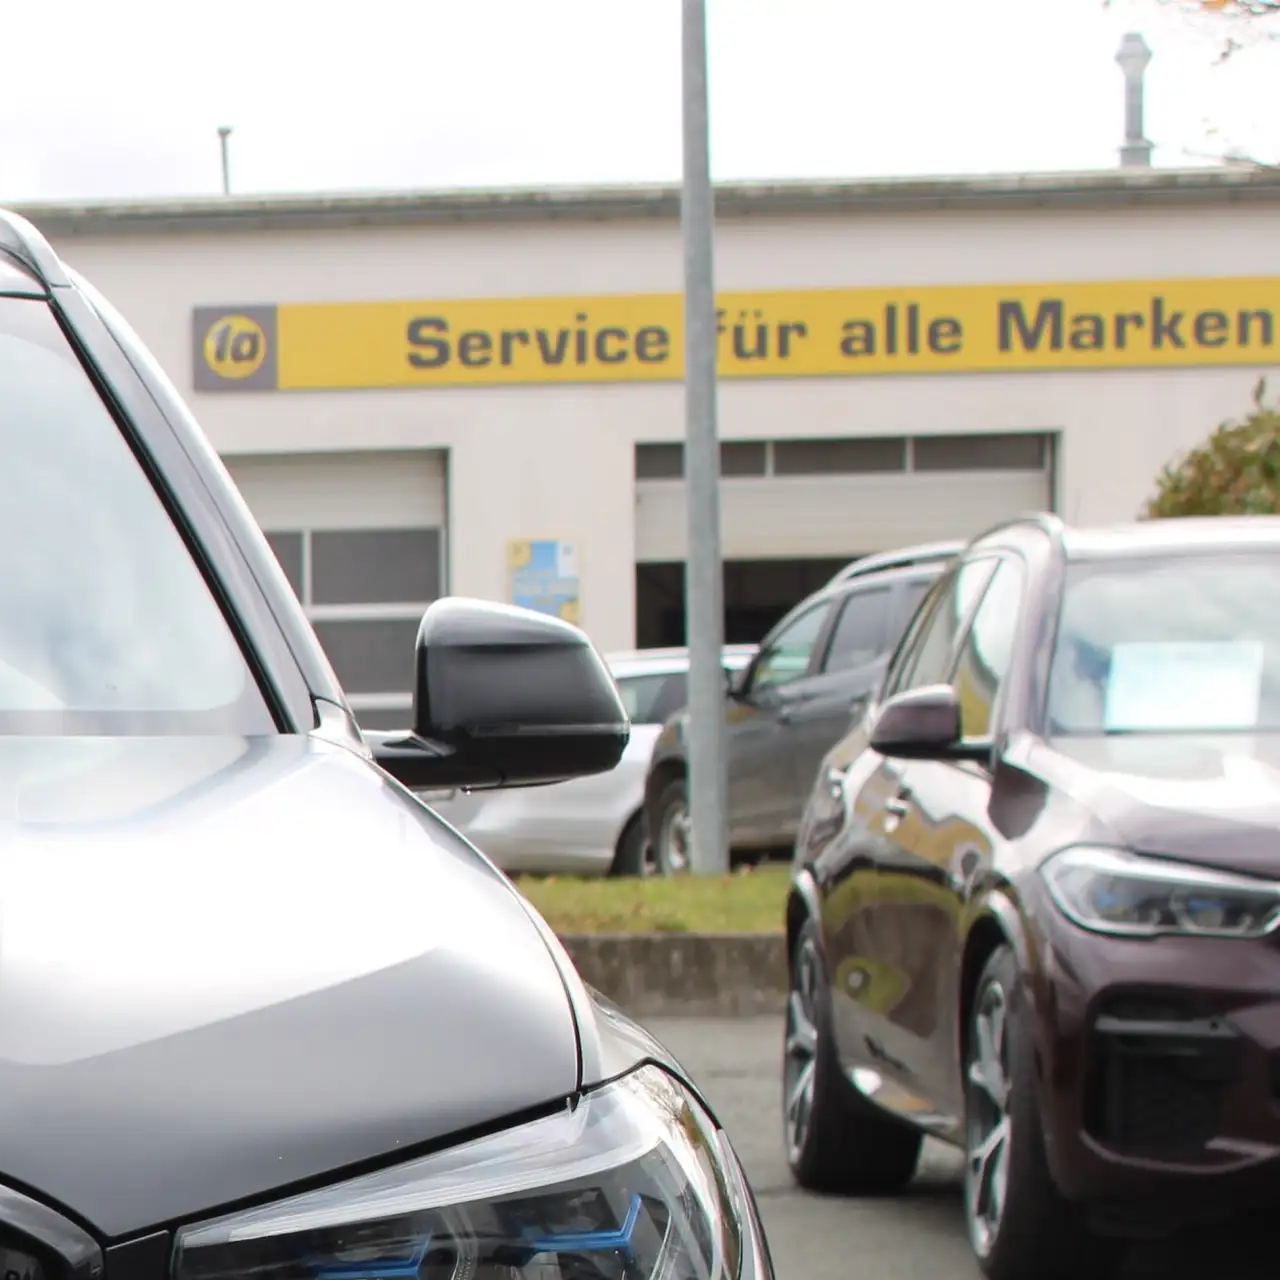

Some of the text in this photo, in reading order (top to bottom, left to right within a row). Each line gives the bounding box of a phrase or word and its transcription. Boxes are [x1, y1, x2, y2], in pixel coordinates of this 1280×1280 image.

[406, 313, 670, 369] Service
[839, 302, 964, 358] alle
[996, 297, 1274, 352] Marken
